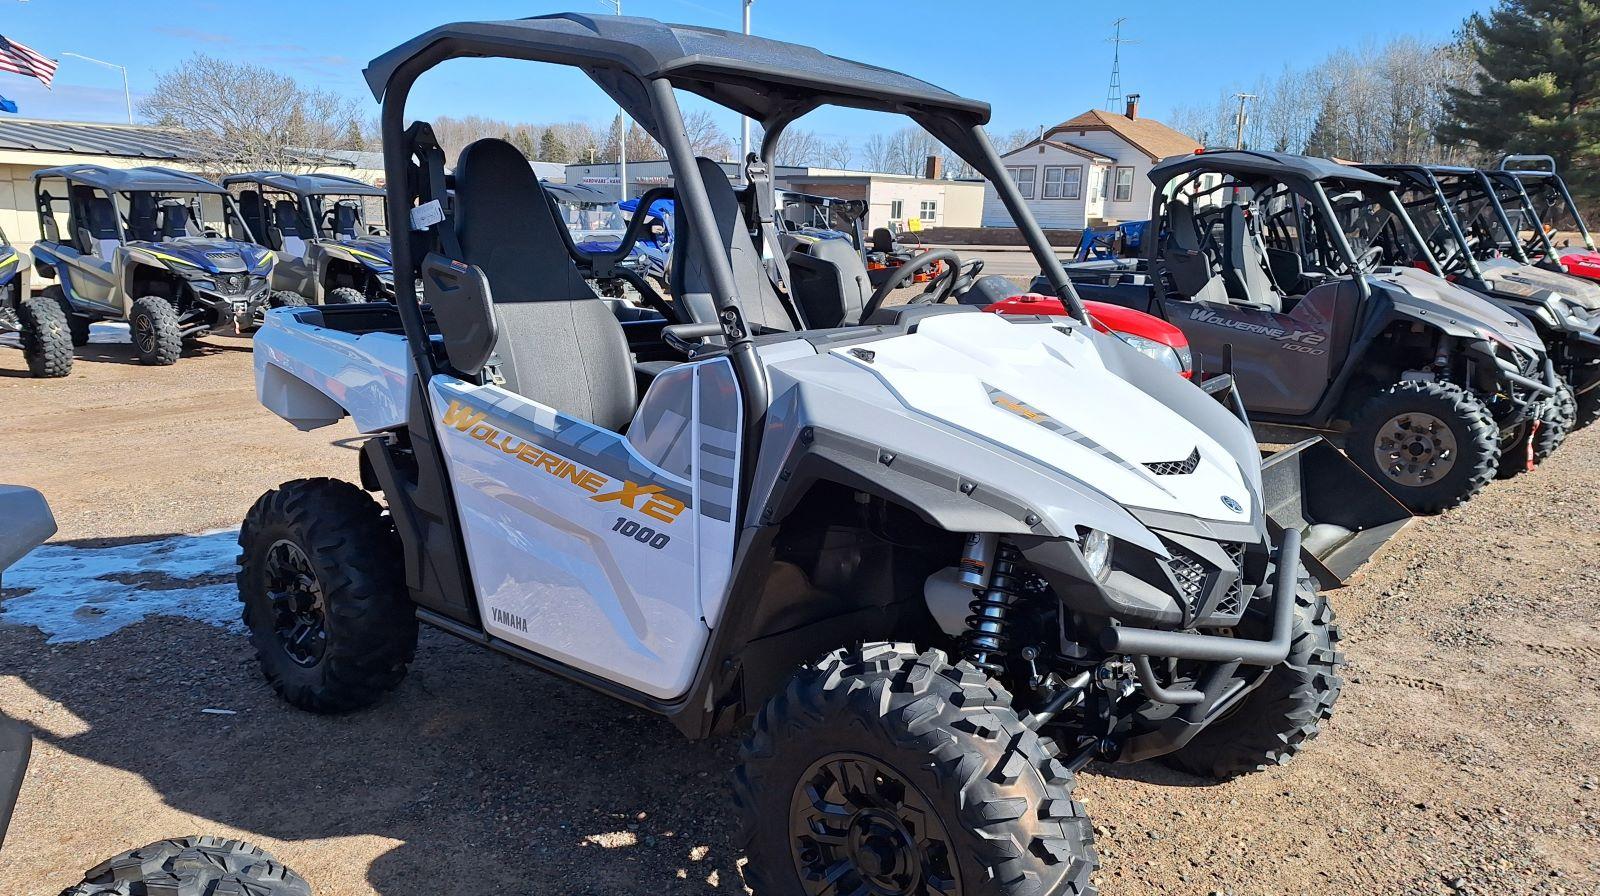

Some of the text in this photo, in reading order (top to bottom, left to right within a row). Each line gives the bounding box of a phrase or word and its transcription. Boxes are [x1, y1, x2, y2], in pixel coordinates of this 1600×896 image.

[1189, 308, 1326, 345] WOLVERINE X2
[1281, 343, 1325, 355] 1000
[442, 400, 685, 524] WOLVERINE X2
[612, 517, 671, 550] 1000
[491, 606, 529, 633] YAMAHA
